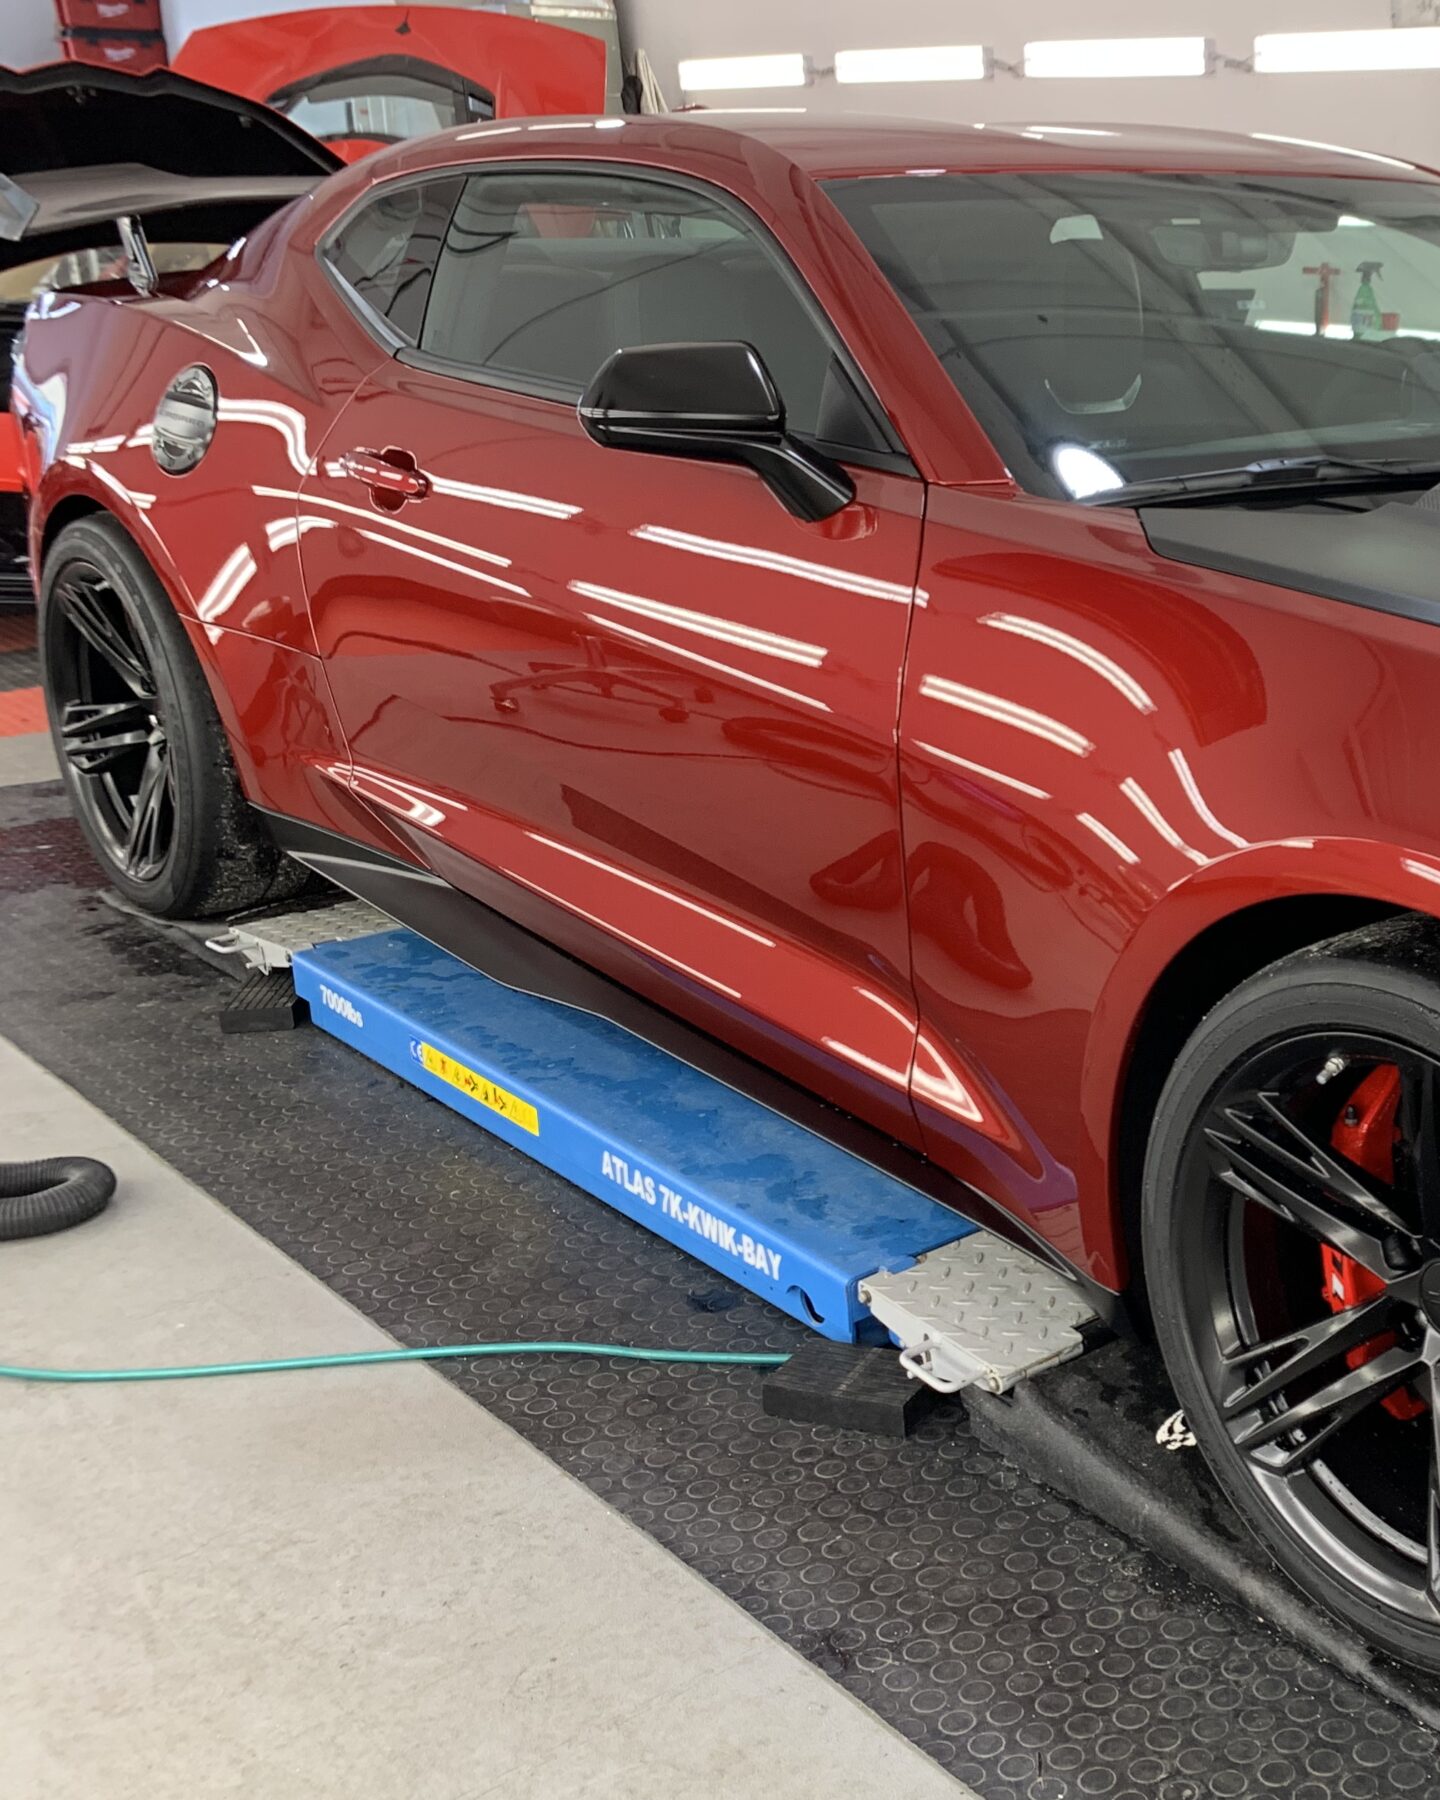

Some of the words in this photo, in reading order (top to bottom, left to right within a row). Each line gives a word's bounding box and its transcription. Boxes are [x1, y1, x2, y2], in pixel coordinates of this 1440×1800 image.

[320, 984, 364, 1028] 7000lbs
[602, 1150, 656, 1206] ATLAS
[659, 1184, 782, 1281] 7K-KWIK-BAY
